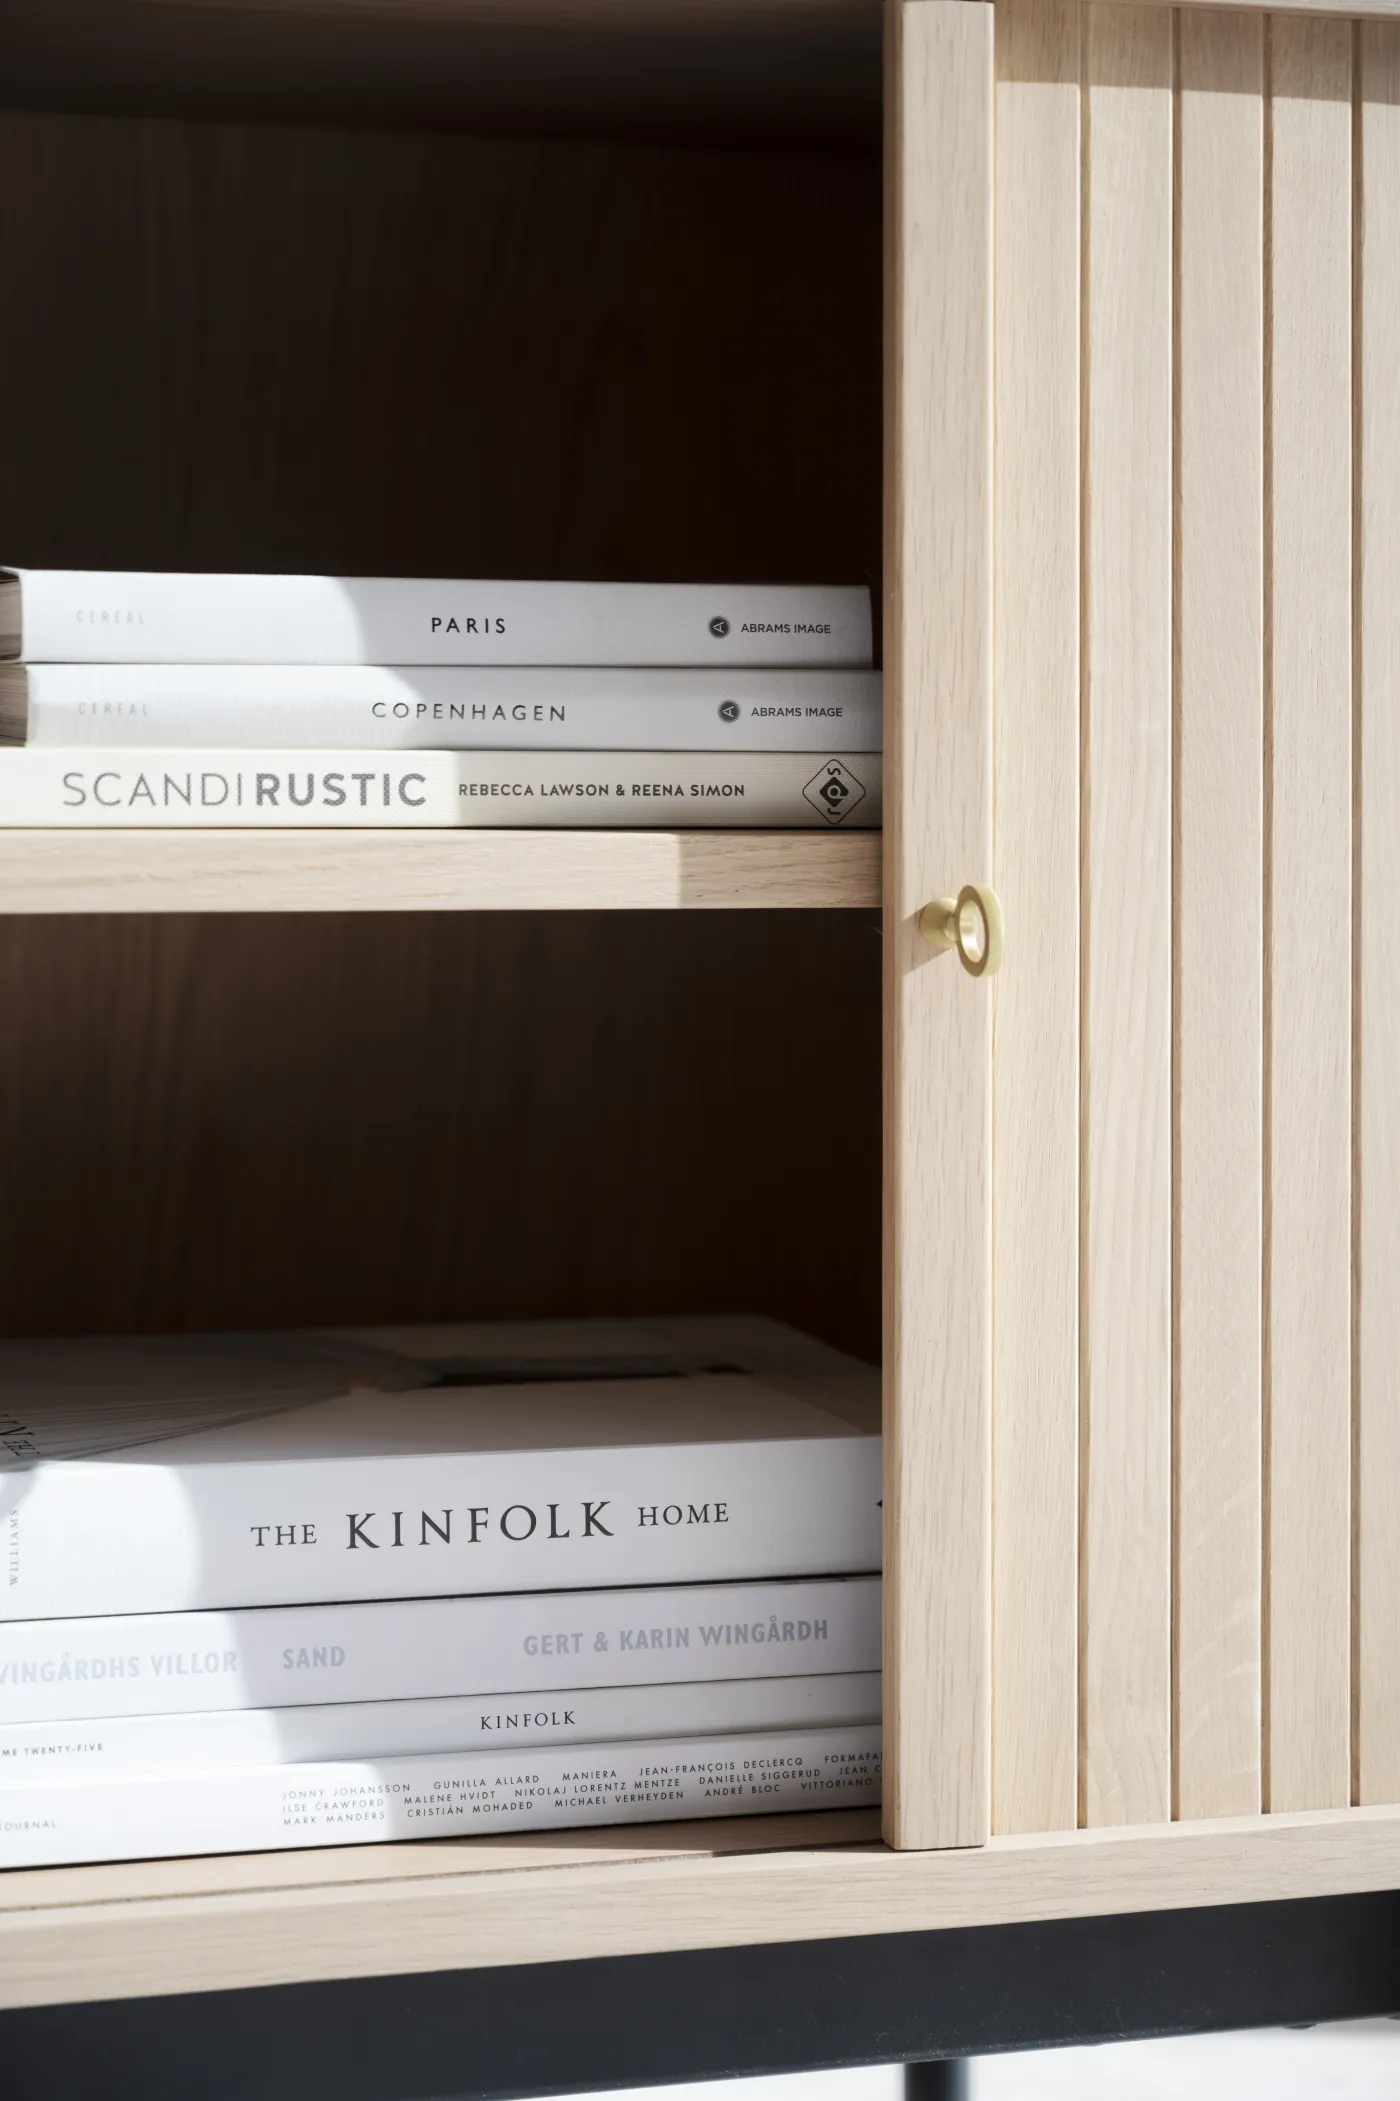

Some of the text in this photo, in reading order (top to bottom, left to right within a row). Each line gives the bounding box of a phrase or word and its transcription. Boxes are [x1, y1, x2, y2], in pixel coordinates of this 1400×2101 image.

[75, 609, 145, 625] CEREAL
[431, 616, 506, 634] PARIS
[740, 623, 832, 634] ABRAMS IMAGE
[77, 701, 148, 717] CEREAL
[371, 702, 565, 722] COPENHAGEN
[750, 707, 843, 718] ABRAMS IMAGE
[458, 783, 745, 797] REBECCA LAWSON & REENA SIMON
[251, 1501, 728, 1549] THE KINFOLK HOME
[9, 1510, 19, 1585] WILLIAMS
[523, 1615, 827, 1656] GERT & KARIN WINGÅRDH
[150, 1652, 236, 1676] VILLOR
[283, 1646, 345, 1670] SAND
[480, 1710, 576, 1730] KINFOLK
[23, 1742, 103, 1756] TWENTY-FIVE
[281, 1750, 883, 1802] JONNY JOHANSSON GUNILLA ALLARD MANIERA JEAN-FRANÇOIS DECLERCQ FORMAFA
[282, 1803, 307, 1813] ILSE
[315, 1798, 384, 1813] CRAWFORD
[403, 1793, 453, 1807] MALENE
[459, 1790, 496, 1801] HVIDT
[514, 1785, 567, 1797] NIKOLAJ
[573, 1779, 628, 1795] LORENTZ
[634, 1778, 680, 1789] MENTZE
[697, 1771, 756, 1787] DANIELLE
[759, 1767, 823, 1783] SIGGERUD
[839, 1765, 869, 1778] JEAN
[283, 1776, 875, 1826] MARK MANDERS CRISTIÁN MOHADED MICHAEL VERHEYDEN ANDRÉ BLOC VITTORIANO
[0, 1819, 57, 1832] OURNAL
